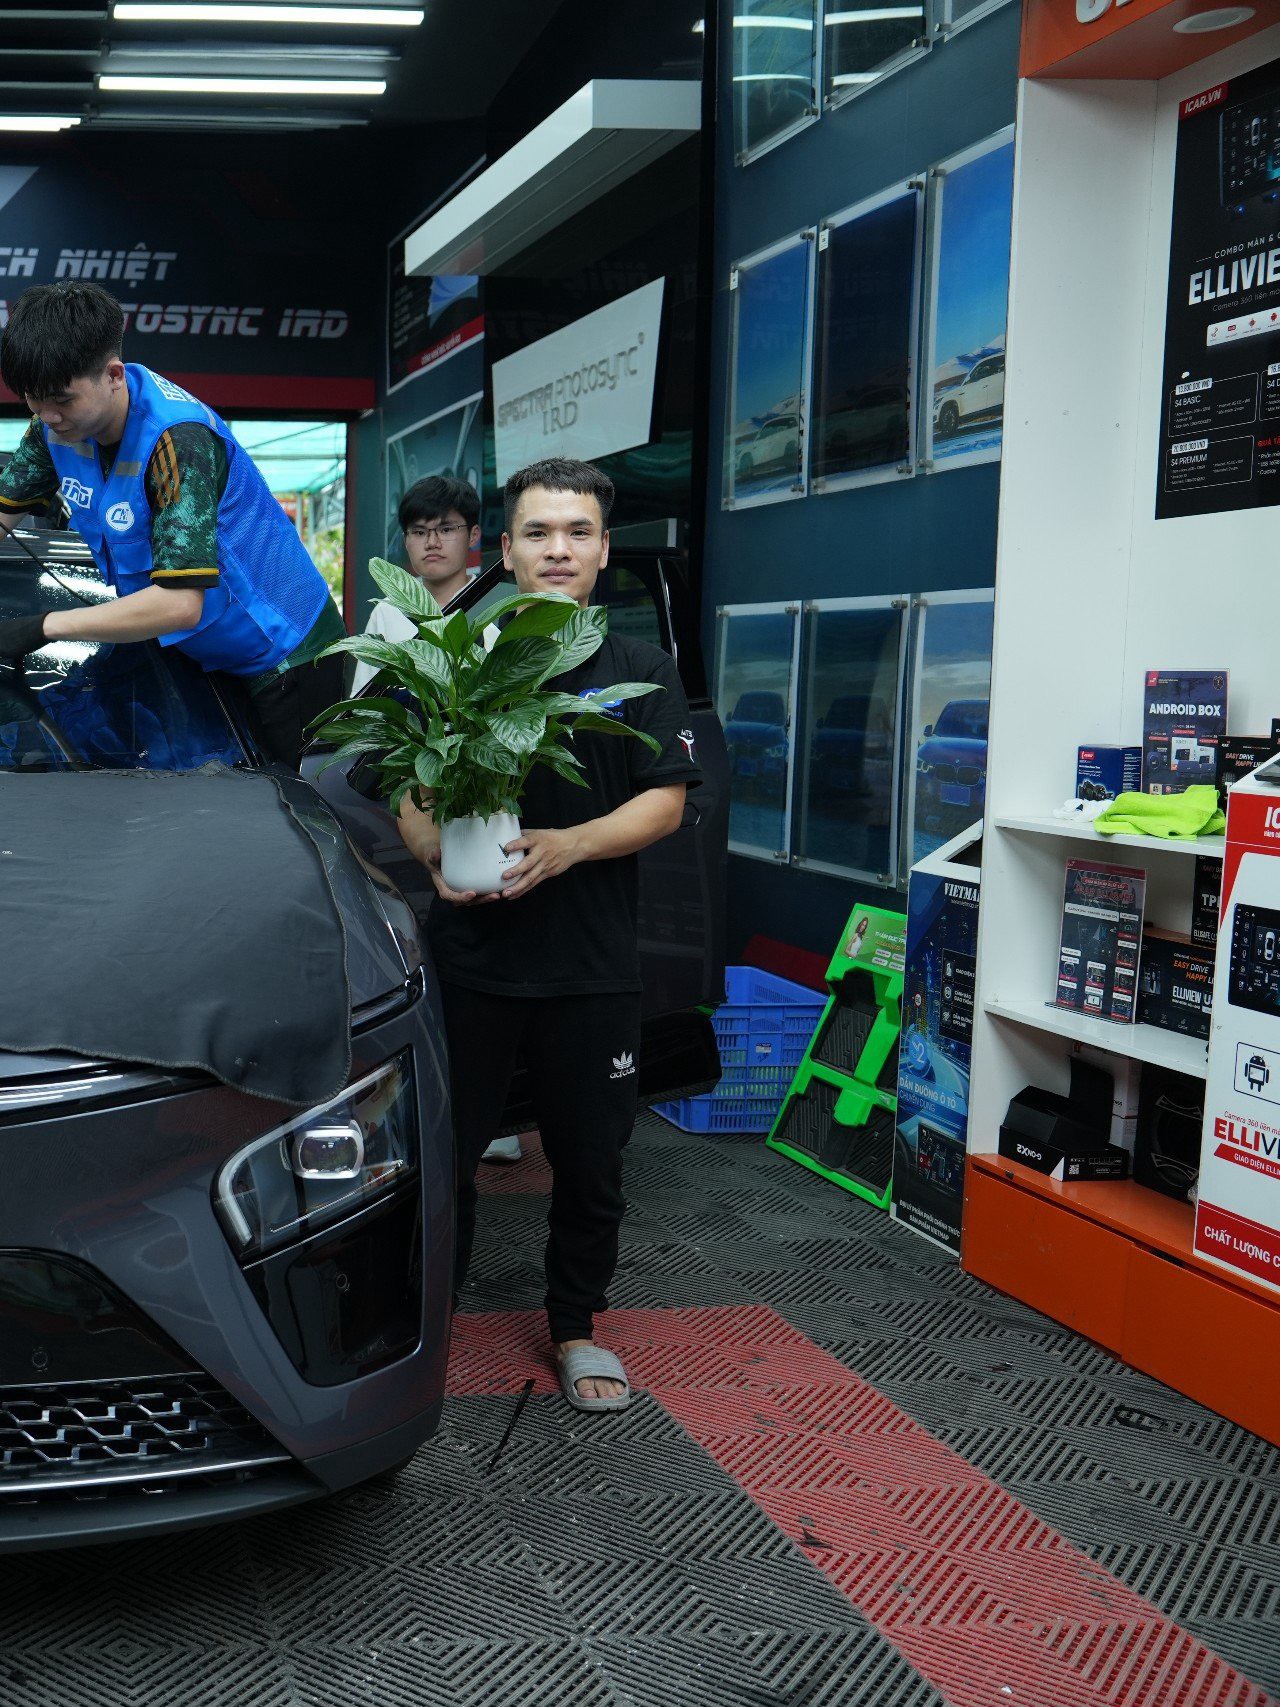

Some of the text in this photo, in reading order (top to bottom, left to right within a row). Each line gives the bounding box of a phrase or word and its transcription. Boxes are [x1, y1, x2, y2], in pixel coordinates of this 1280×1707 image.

[1184, 88, 1222, 114] ICAR.VN
[1214, 243, 1245, 259] COMBO
[1247, 236, 1265, 249] MÀN
[54, 242, 177, 287] NHIỆT
[278, 308, 349, 338] IRD
[542, 401, 579, 436] IRD
[1149, 703, 1222, 717] ANDROID BOX
[1173, 960, 1209, 974] EASY DRIVE
[1185, 971, 1207, 983] HAPPY
[1172, 985, 1202, 1005] ELLIVIEW
[1224, 1110, 1246, 1124] Camera
[1247, 1118, 1259, 1128] 360
[1233, 1153, 1249, 1164] GIAO
[1250, 1158, 1265, 1170] DIỆN
[1204, 1225, 1232, 1246] CHẤT
[1233, 1237, 1270, 1264] LƯỢNG
